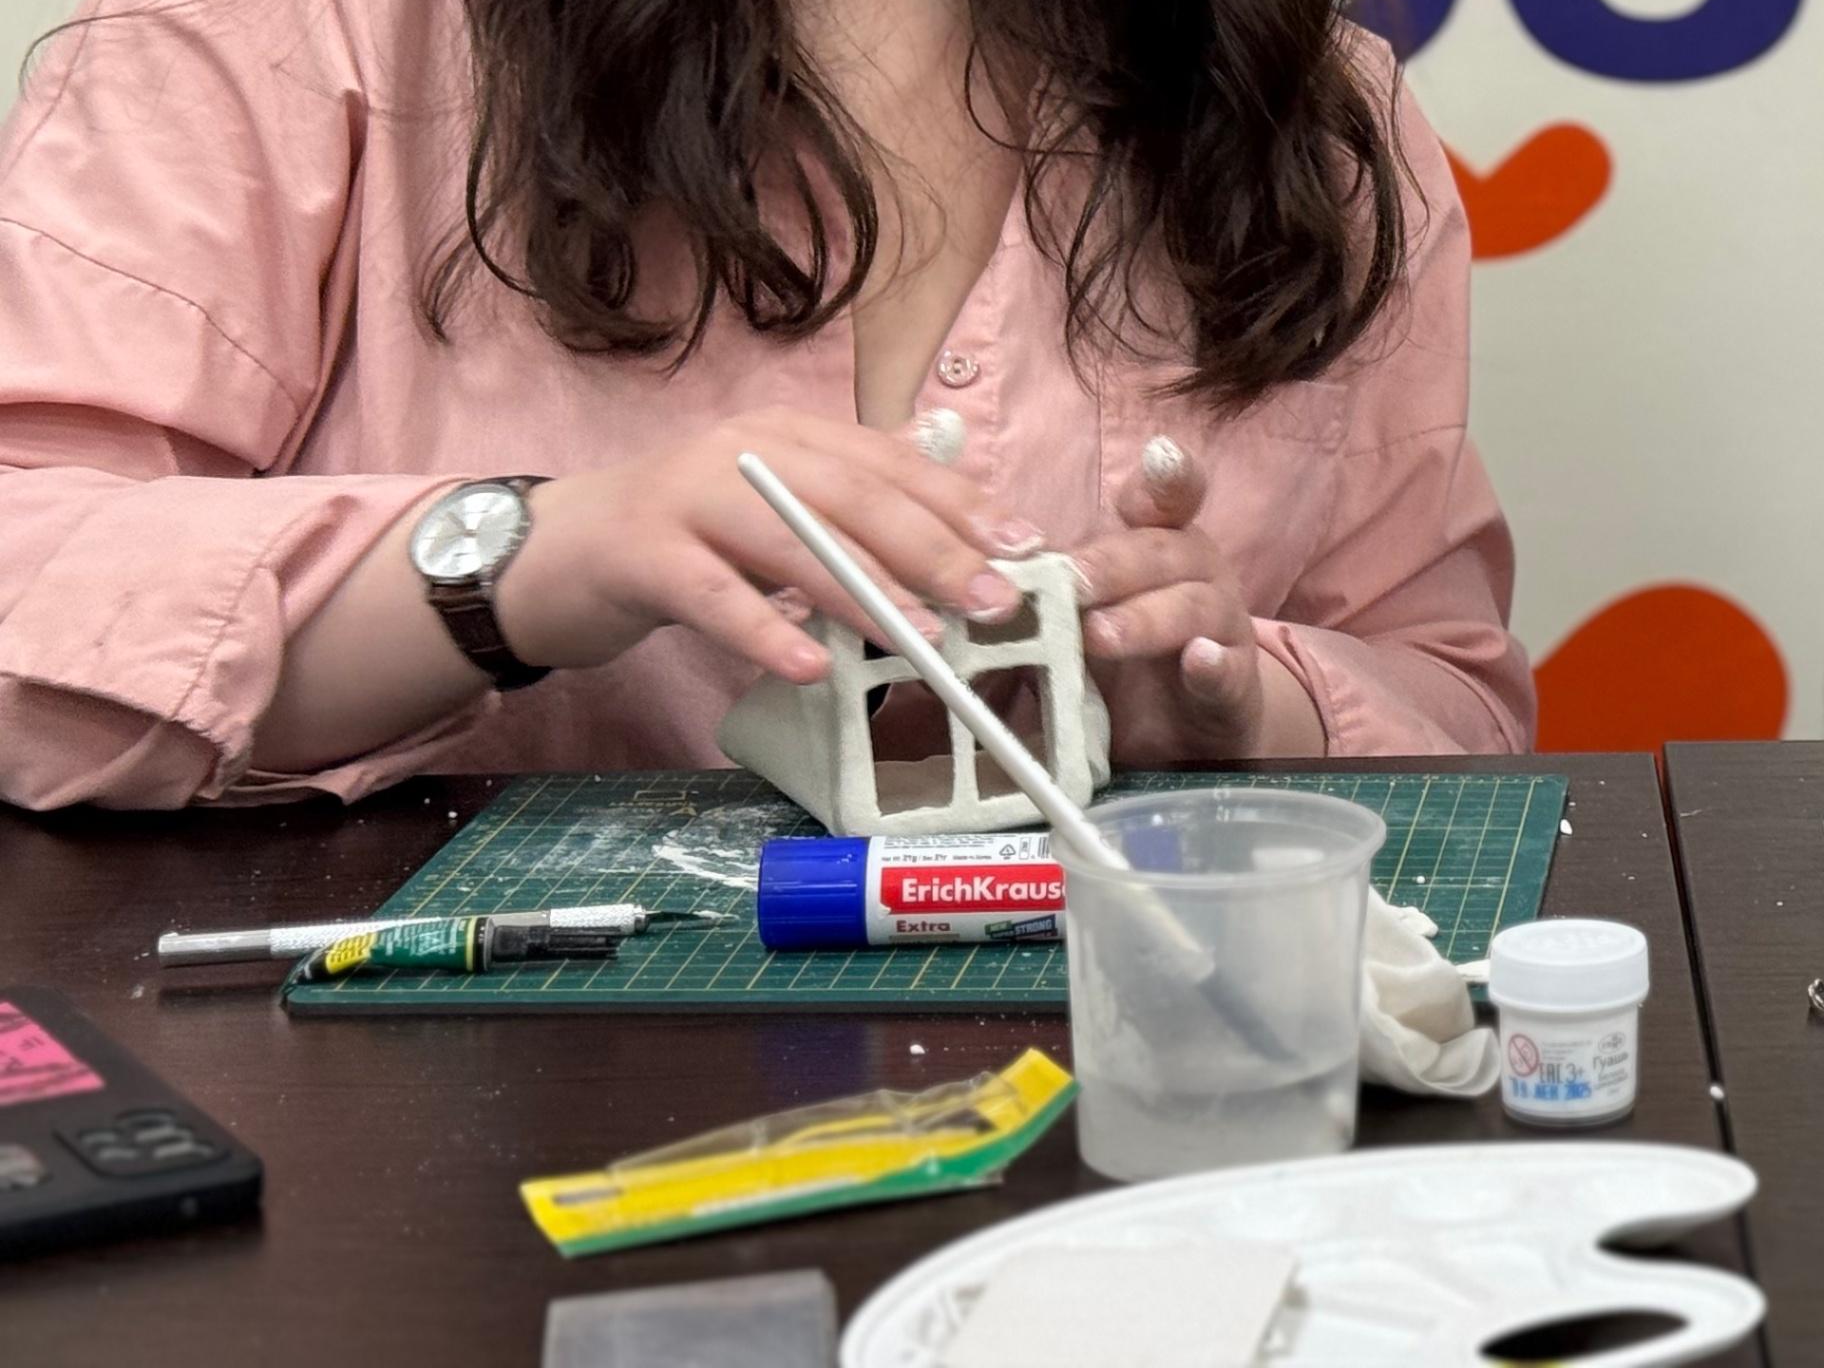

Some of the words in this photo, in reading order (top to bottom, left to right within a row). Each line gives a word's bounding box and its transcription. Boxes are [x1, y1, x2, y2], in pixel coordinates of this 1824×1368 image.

[902, 876, 1066, 903] ErichKraus
[896, 920, 950, 933] Extra
[1015, 918, 1053, 935] STRONG
